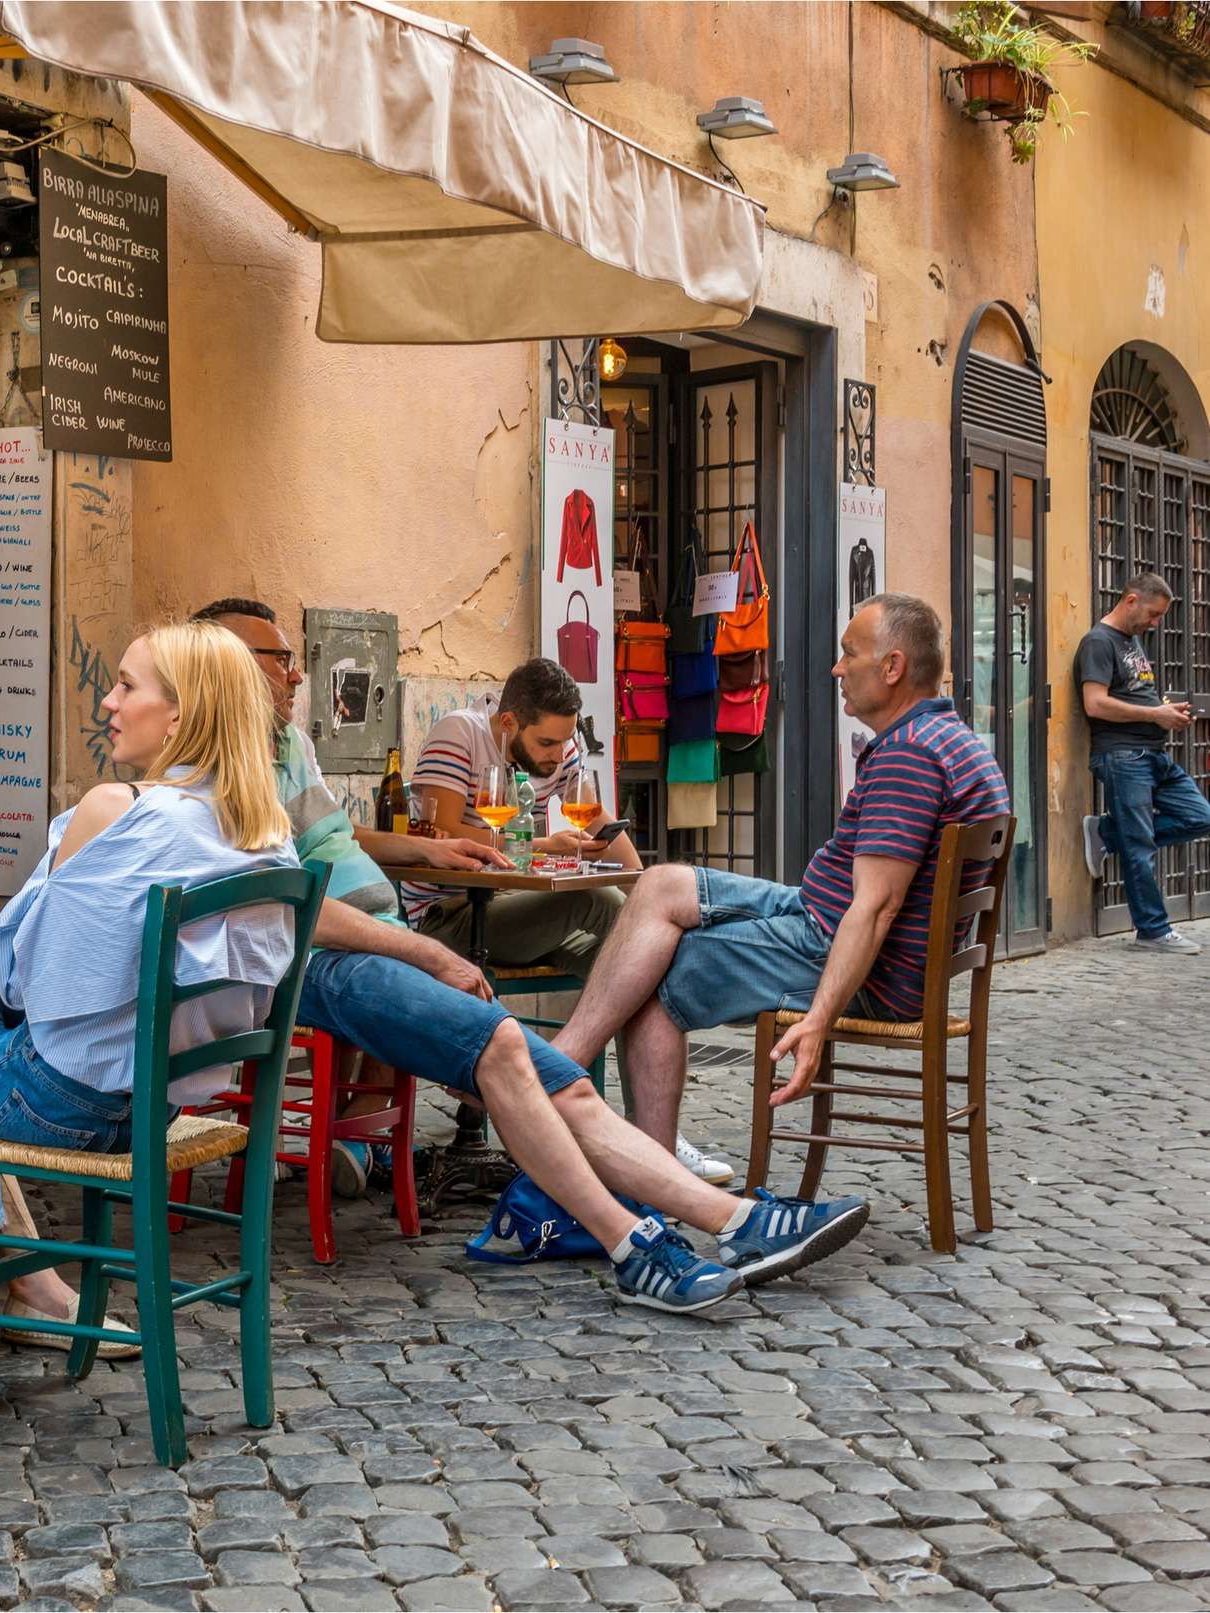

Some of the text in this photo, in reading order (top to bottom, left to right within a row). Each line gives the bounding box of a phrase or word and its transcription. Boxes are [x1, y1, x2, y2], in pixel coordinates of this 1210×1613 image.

[43, 168, 83, 199] BIRRA
[53, 217, 160, 263] LOCAL CRAFT BEER
[52, 306, 167, 335] MOJITO CAIPIRINHA
[49, 353, 98, 375] NEGRONI
[111, 345, 159, 366] MOSKOW
[132, 368, 160, 383] MULE
[50, 394, 82, 415] IRISH
[104, 386, 166, 411] AMERICANO
[52, 414, 126, 431] CIDER WINE
[127, 434, 170, 452] PROSECCO
[549, 437, 609, 463] SANYA
[842, 498, 883, 517] SANYA
[12, 565, 33, 573] WINE
[15, 629, 39, 638] CIDER
[7, 686, 36, 696] DRINKS
